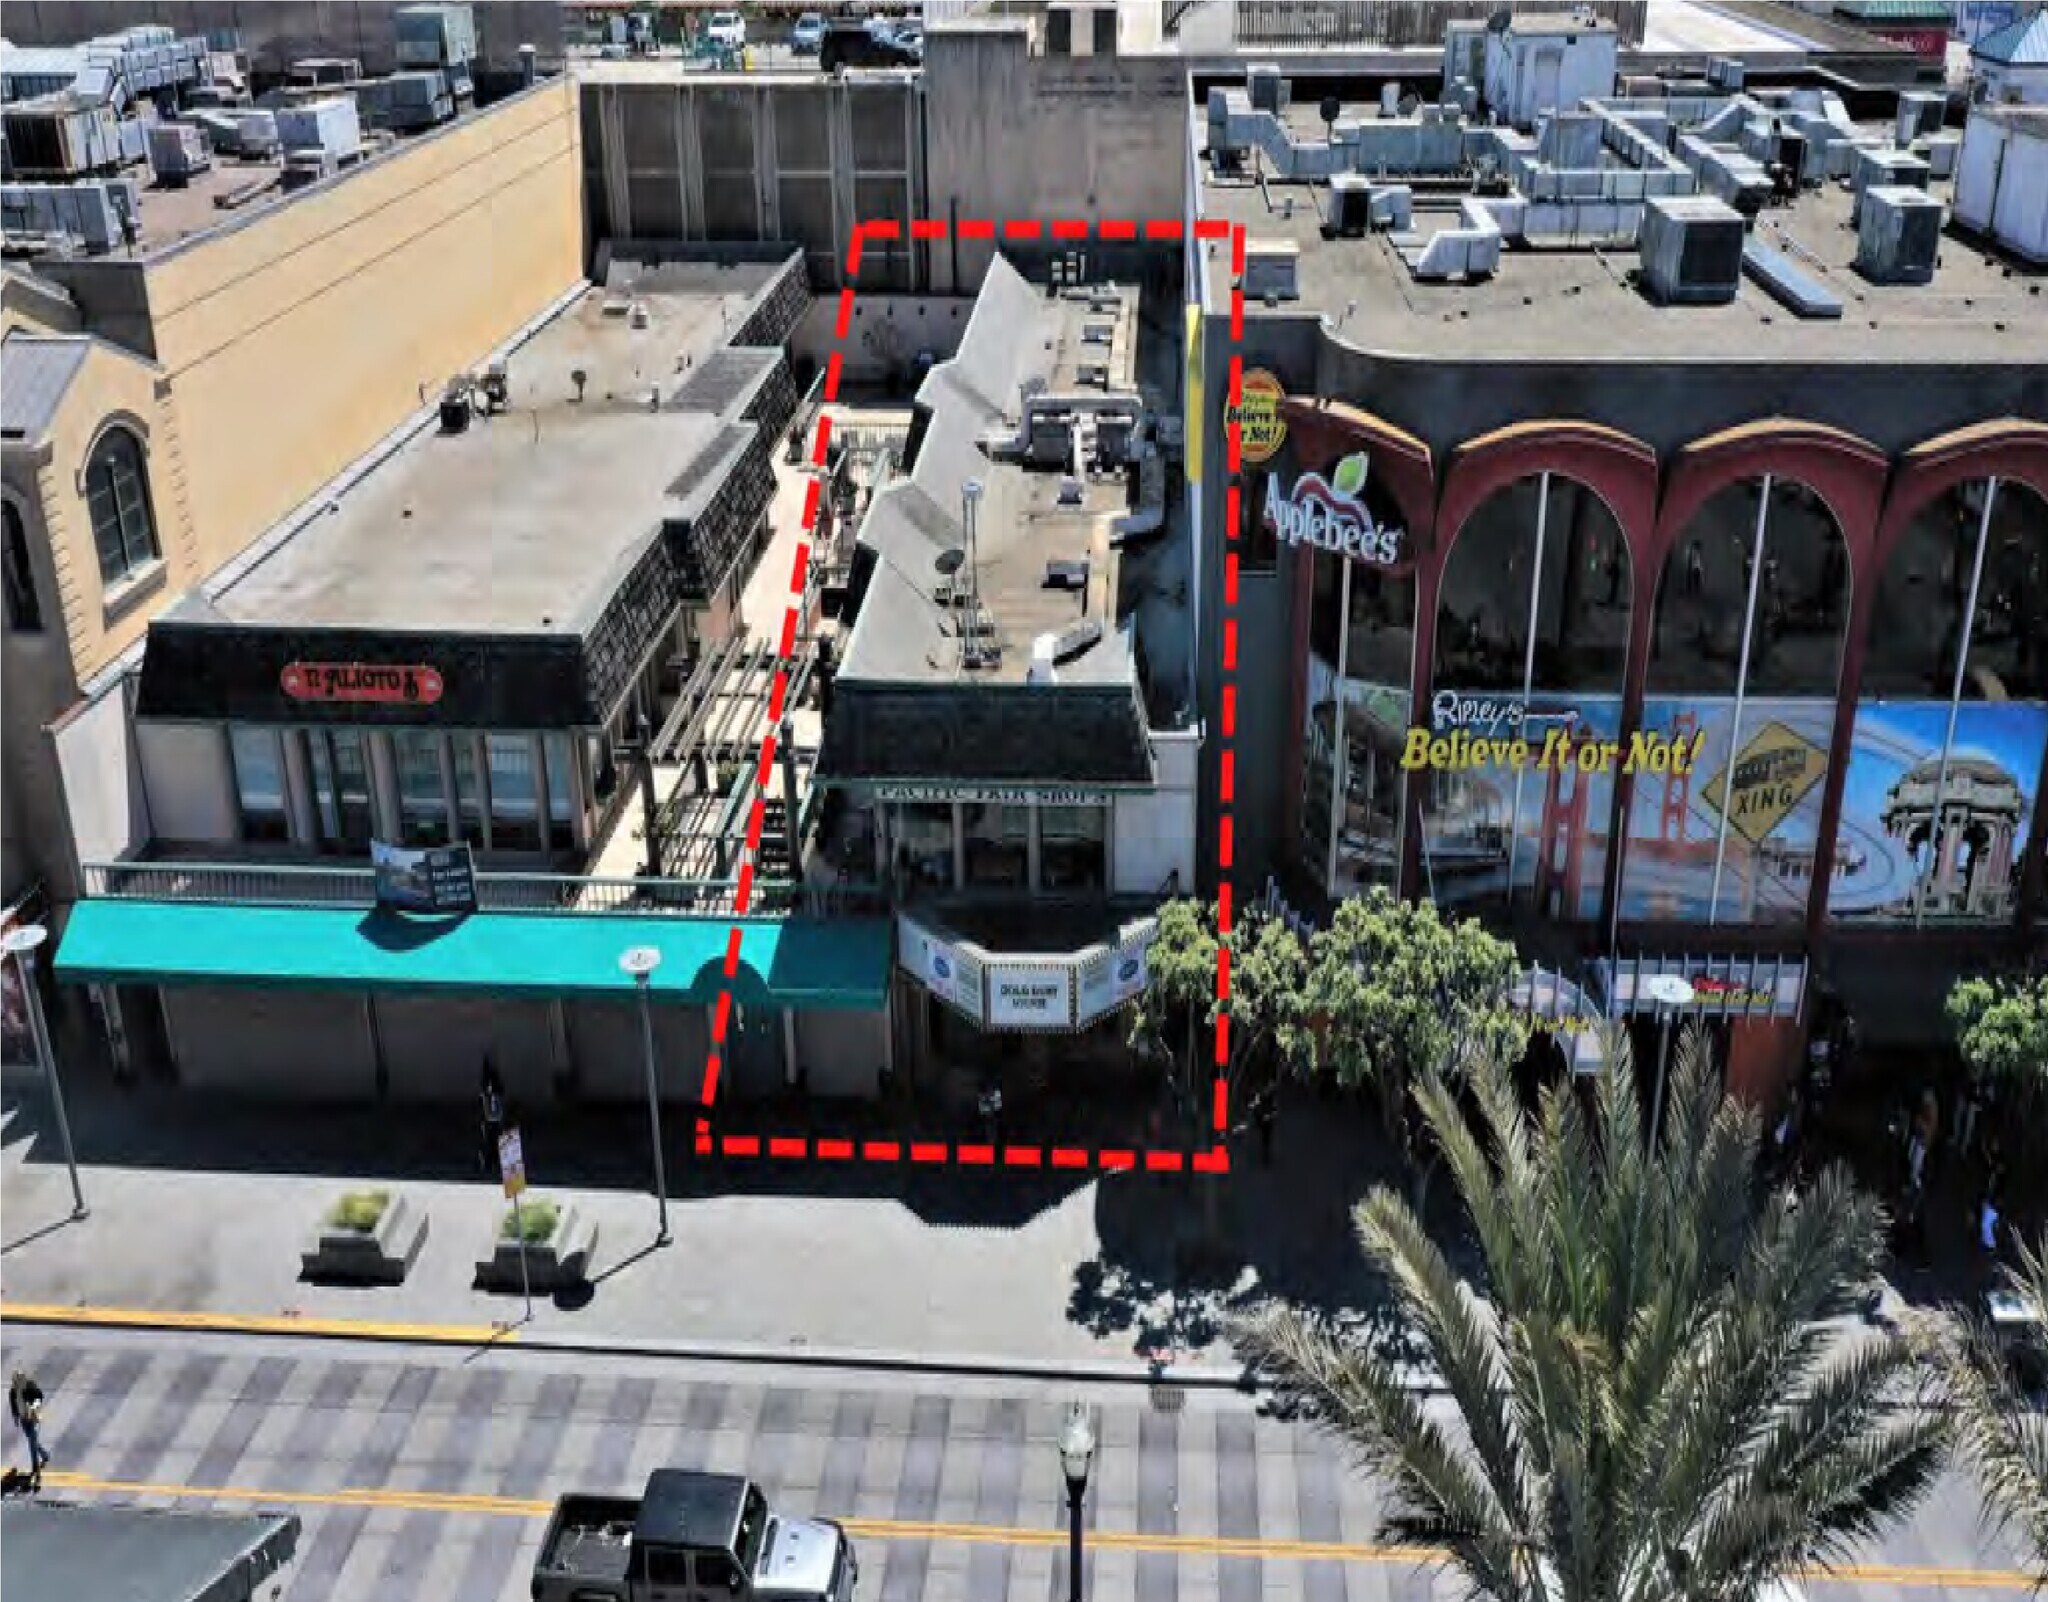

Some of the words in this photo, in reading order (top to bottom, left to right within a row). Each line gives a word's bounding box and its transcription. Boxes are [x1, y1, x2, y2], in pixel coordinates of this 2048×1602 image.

[1263, 471, 1405, 564] Applebee's
[1400, 724, 1529, 771] Believe
[1536, 728, 1571, 773] It
[1577, 742, 1619, 774] or
[1622, 725, 1706, 775] Not!
[1735, 783, 1793, 817] XING
